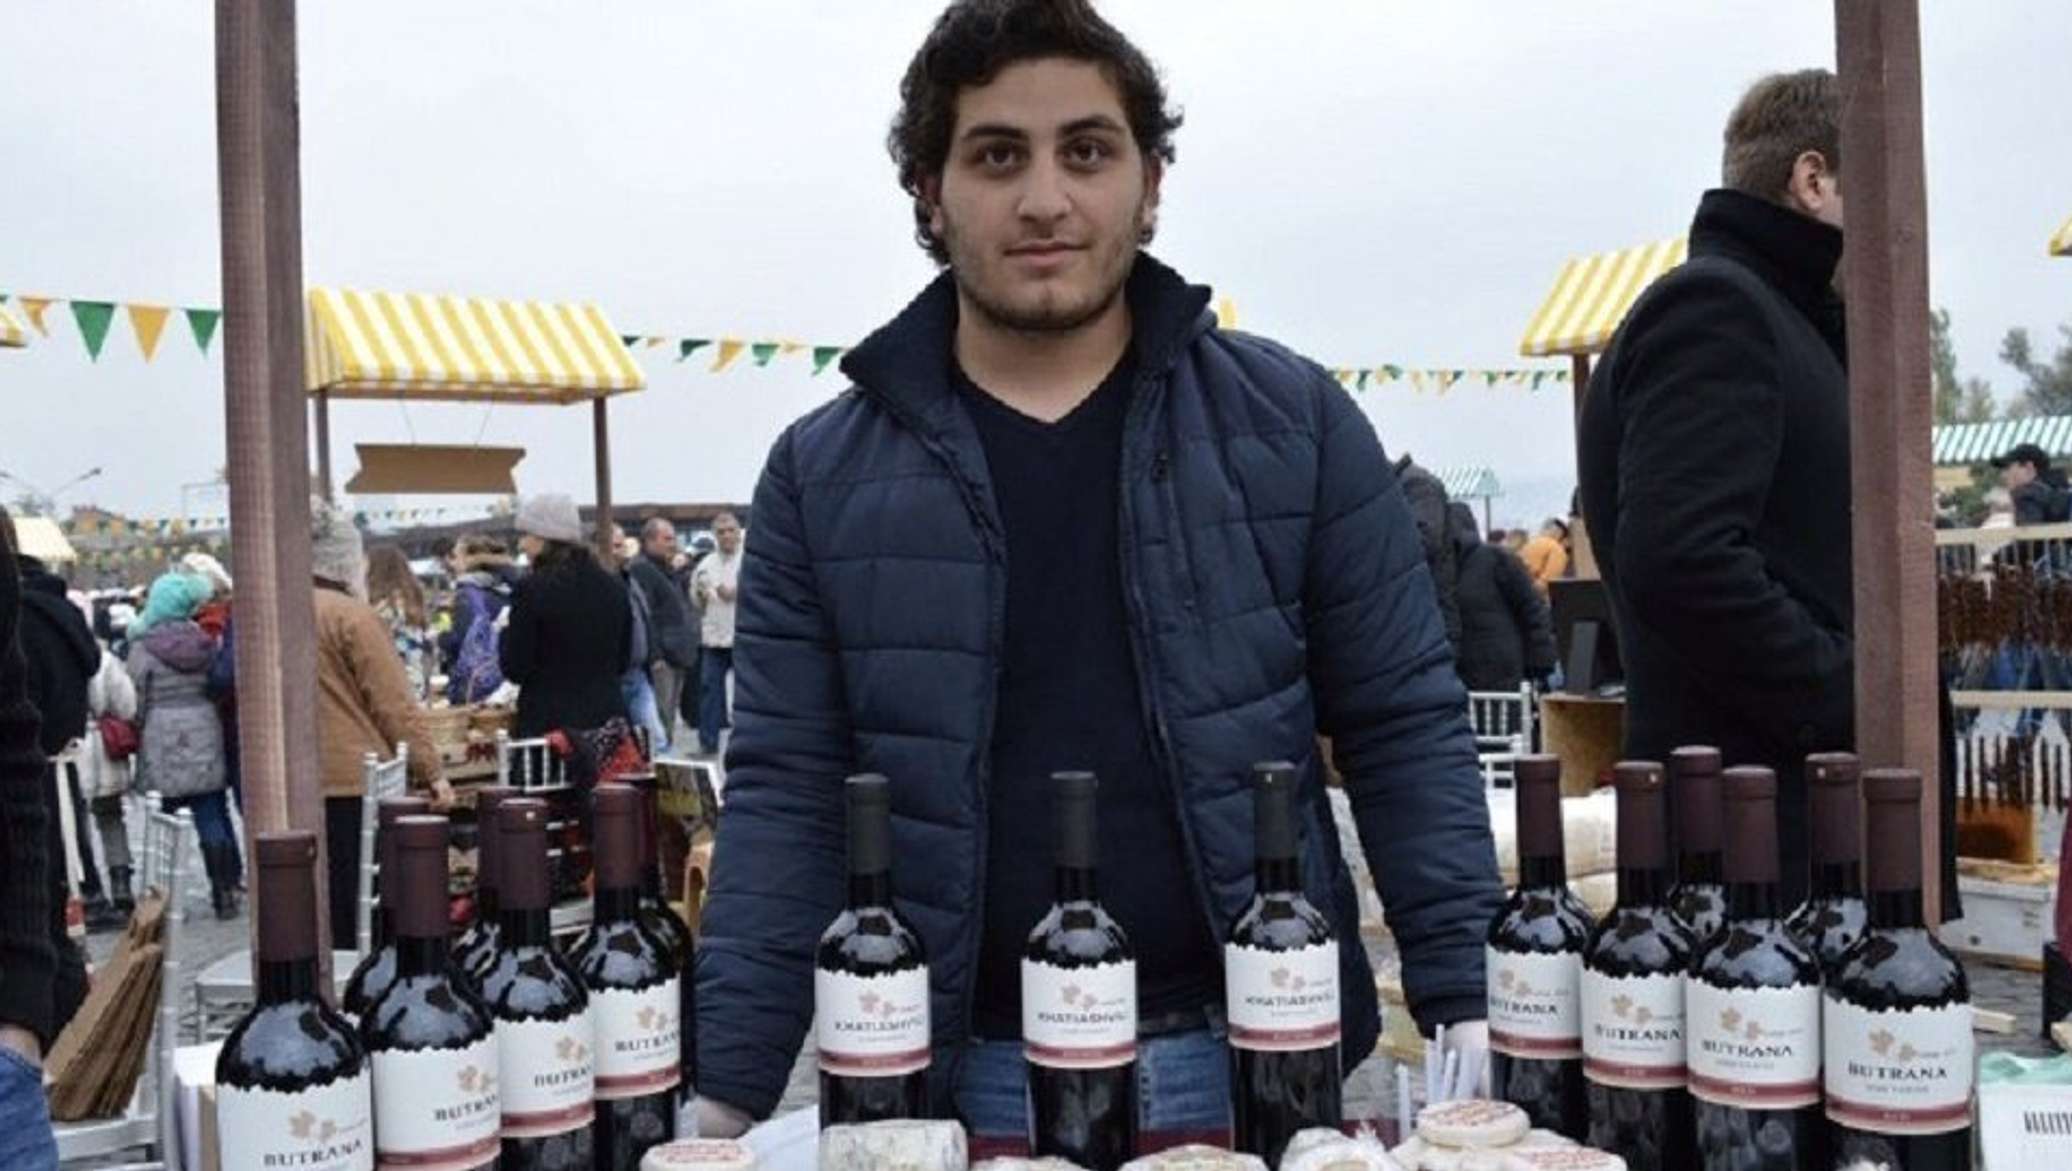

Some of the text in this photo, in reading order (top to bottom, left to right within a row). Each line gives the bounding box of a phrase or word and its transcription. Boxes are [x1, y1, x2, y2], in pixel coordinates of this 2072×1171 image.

[615, 1031, 680, 1052] BUTRAN
[1702, 1038, 1793, 1058] BUTRANA
[534, 1063, 593, 1089] BUTRAN
[1847, 1060, 1948, 1080] BUTRANA
[434, 1093, 497, 1122] BUTRAN
[262, 1138, 362, 1168] BUTRANA
